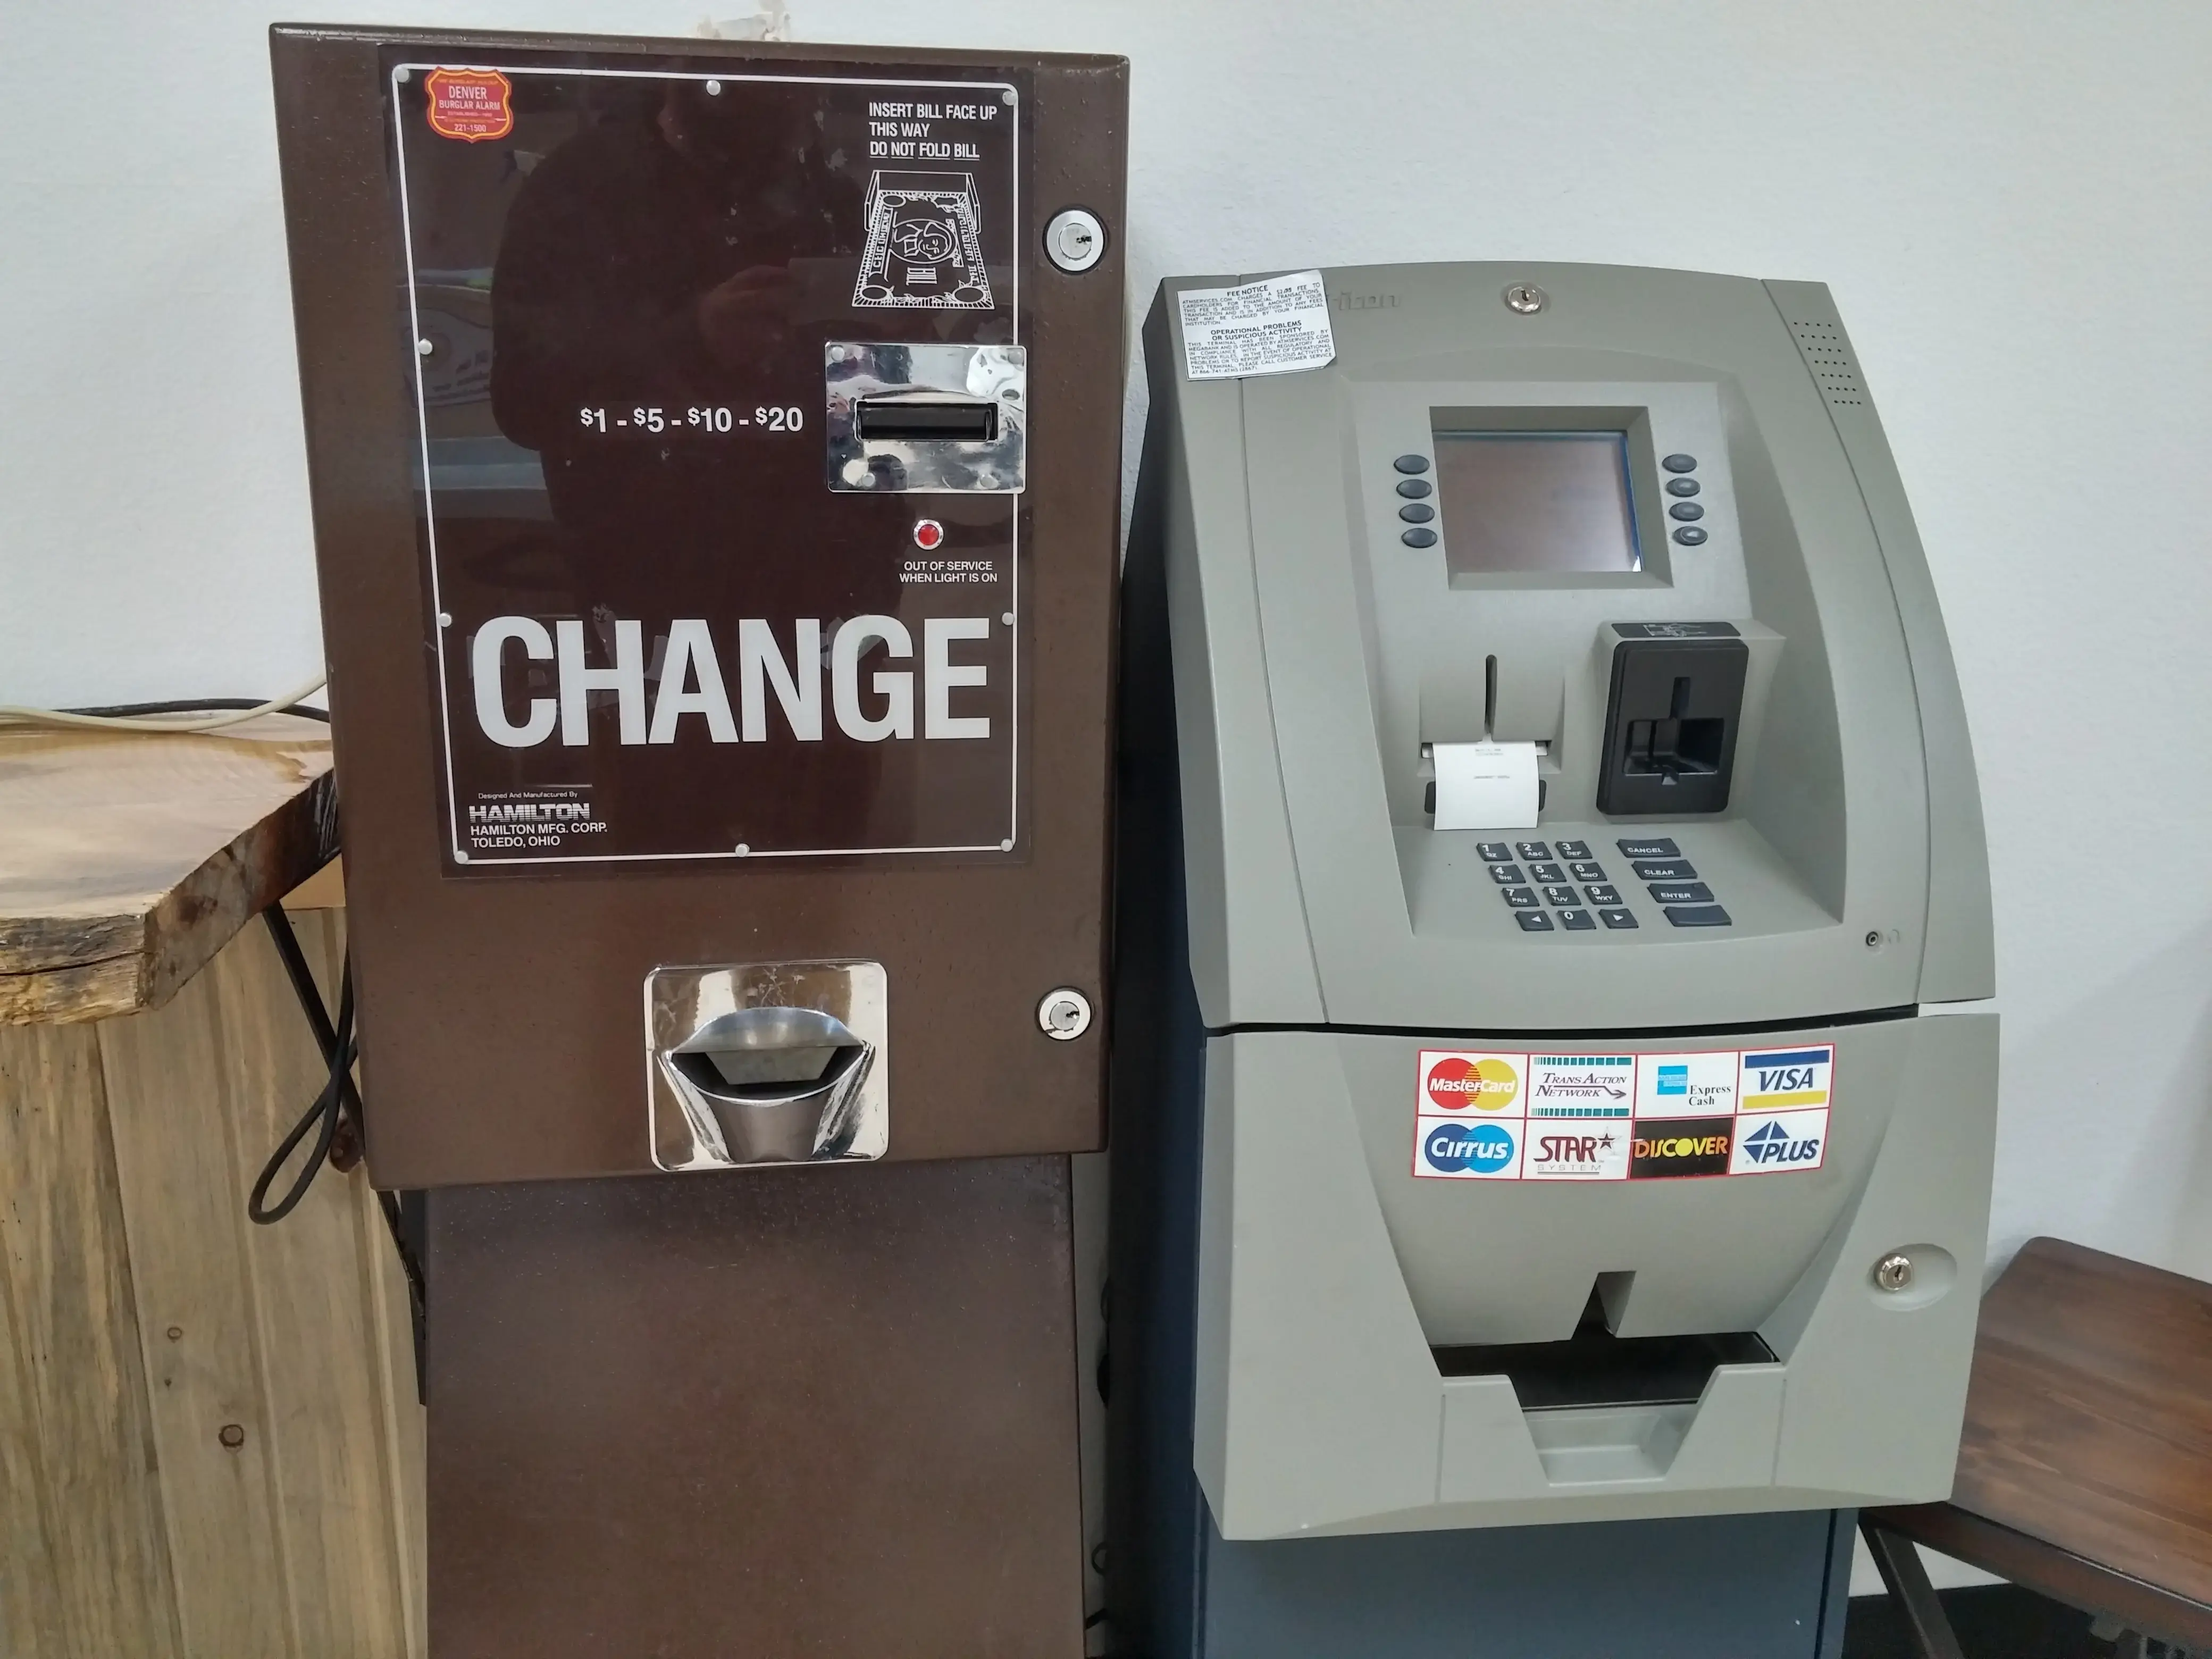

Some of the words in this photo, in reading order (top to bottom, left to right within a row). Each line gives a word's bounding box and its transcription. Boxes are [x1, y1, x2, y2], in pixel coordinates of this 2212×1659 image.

[449, 86, 487, 99] DENVER
[439, 99, 473, 109] BURGLAR
[476, 101, 500, 110] ALARM
[869, 102, 913, 117] INSERT
[917, 104, 942, 118] BILL
[946, 105, 976, 119] FACE
[979, 106, 998, 120] UP
[454, 123, 486, 132] 221-1500
[869, 122, 898, 137] THIS
[901, 123, 930, 137] WAY
[870, 141, 887, 155] DO
[891, 141, 916, 156] NOT
[919, 143, 950, 156] FOLD
[954, 144, 979, 157] BILL
[1242, 285, 1268, 295] NOTICE
[1263, 320, 1301, 330] PROBLEMS
[581, 407, 606, 432] $1
[633, 407, 664, 432] $5
[688, 407, 732, 432] $10
[755, 406, 803, 432] $20
[904, 562, 927, 571] OUT
[930, 562, 945, 571] OF
[947, 562, 992, 571] SERVICE
[899, 573, 932, 582] WHEN
[935, 573, 966, 582] LIGHT
[969, 574, 979, 582] IS
[982, 573, 997, 582] ON
[472, 614, 990, 748] CHANGE
[468, 803, 590, 823] HAMILTON
[471, 824, 535, 835] HAMILTON
[538, 824, 568, 834] MFG.
[571, 823, 607, 833] CORP.
[471, 837, 526, 848] TOLEDO,
[529, 836, 560, 846] OHIO
[1430, 1078, 1515, 1093] MasterCard
[1759, 1068, 1813, 1091] VISA
[1535, 1085, 1602, 1096] NETWORK
[1690, 1085, 1731, 1095] Express
[1689, 1096, 1714, 1105] Cash
[1431, 1137, 1509, 1159] Cirrus
[1534, 1137, 1597, 1162] STAR
[1634, 1137, 1728, 1158] DISCOVER
[1761, 1139, 1820, 1163] PLUS
